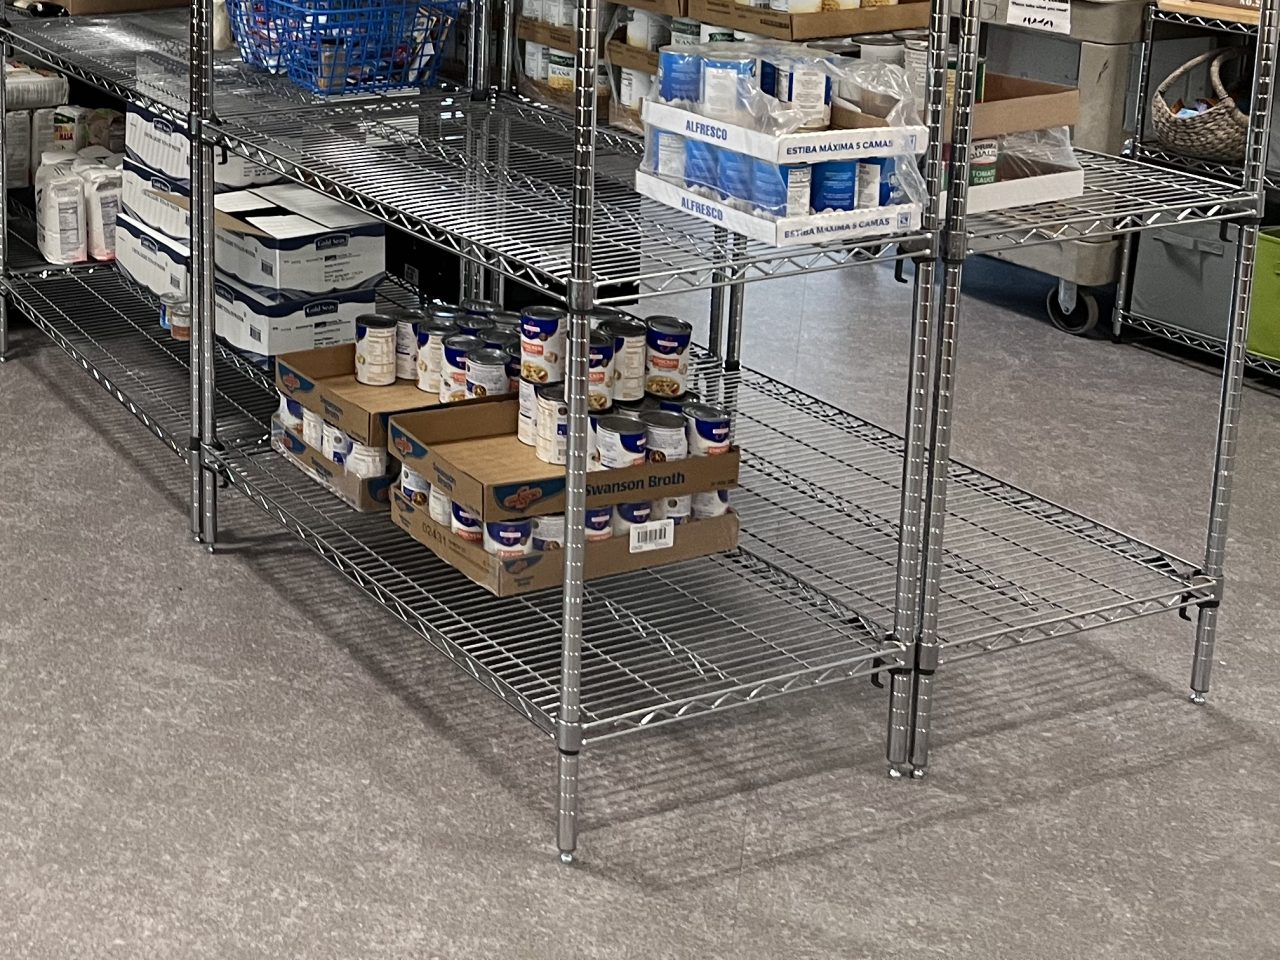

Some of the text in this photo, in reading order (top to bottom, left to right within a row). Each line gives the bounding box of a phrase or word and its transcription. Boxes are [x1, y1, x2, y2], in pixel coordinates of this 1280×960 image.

[685, 119, 728, 141] ALFRESCO
[786, 145, 818, 156] ESTIBA
[818, 140, 854, 154] MÁXIMA
[862, 139, 893, 150] CAMAS
[681, 197, 723, 221] ALFRESCO
[784, 227, 815, 239] ESTIBA
[859, 217, 890, 229] CAMAS
[586, 471, 686, 497] Swanson Broth
